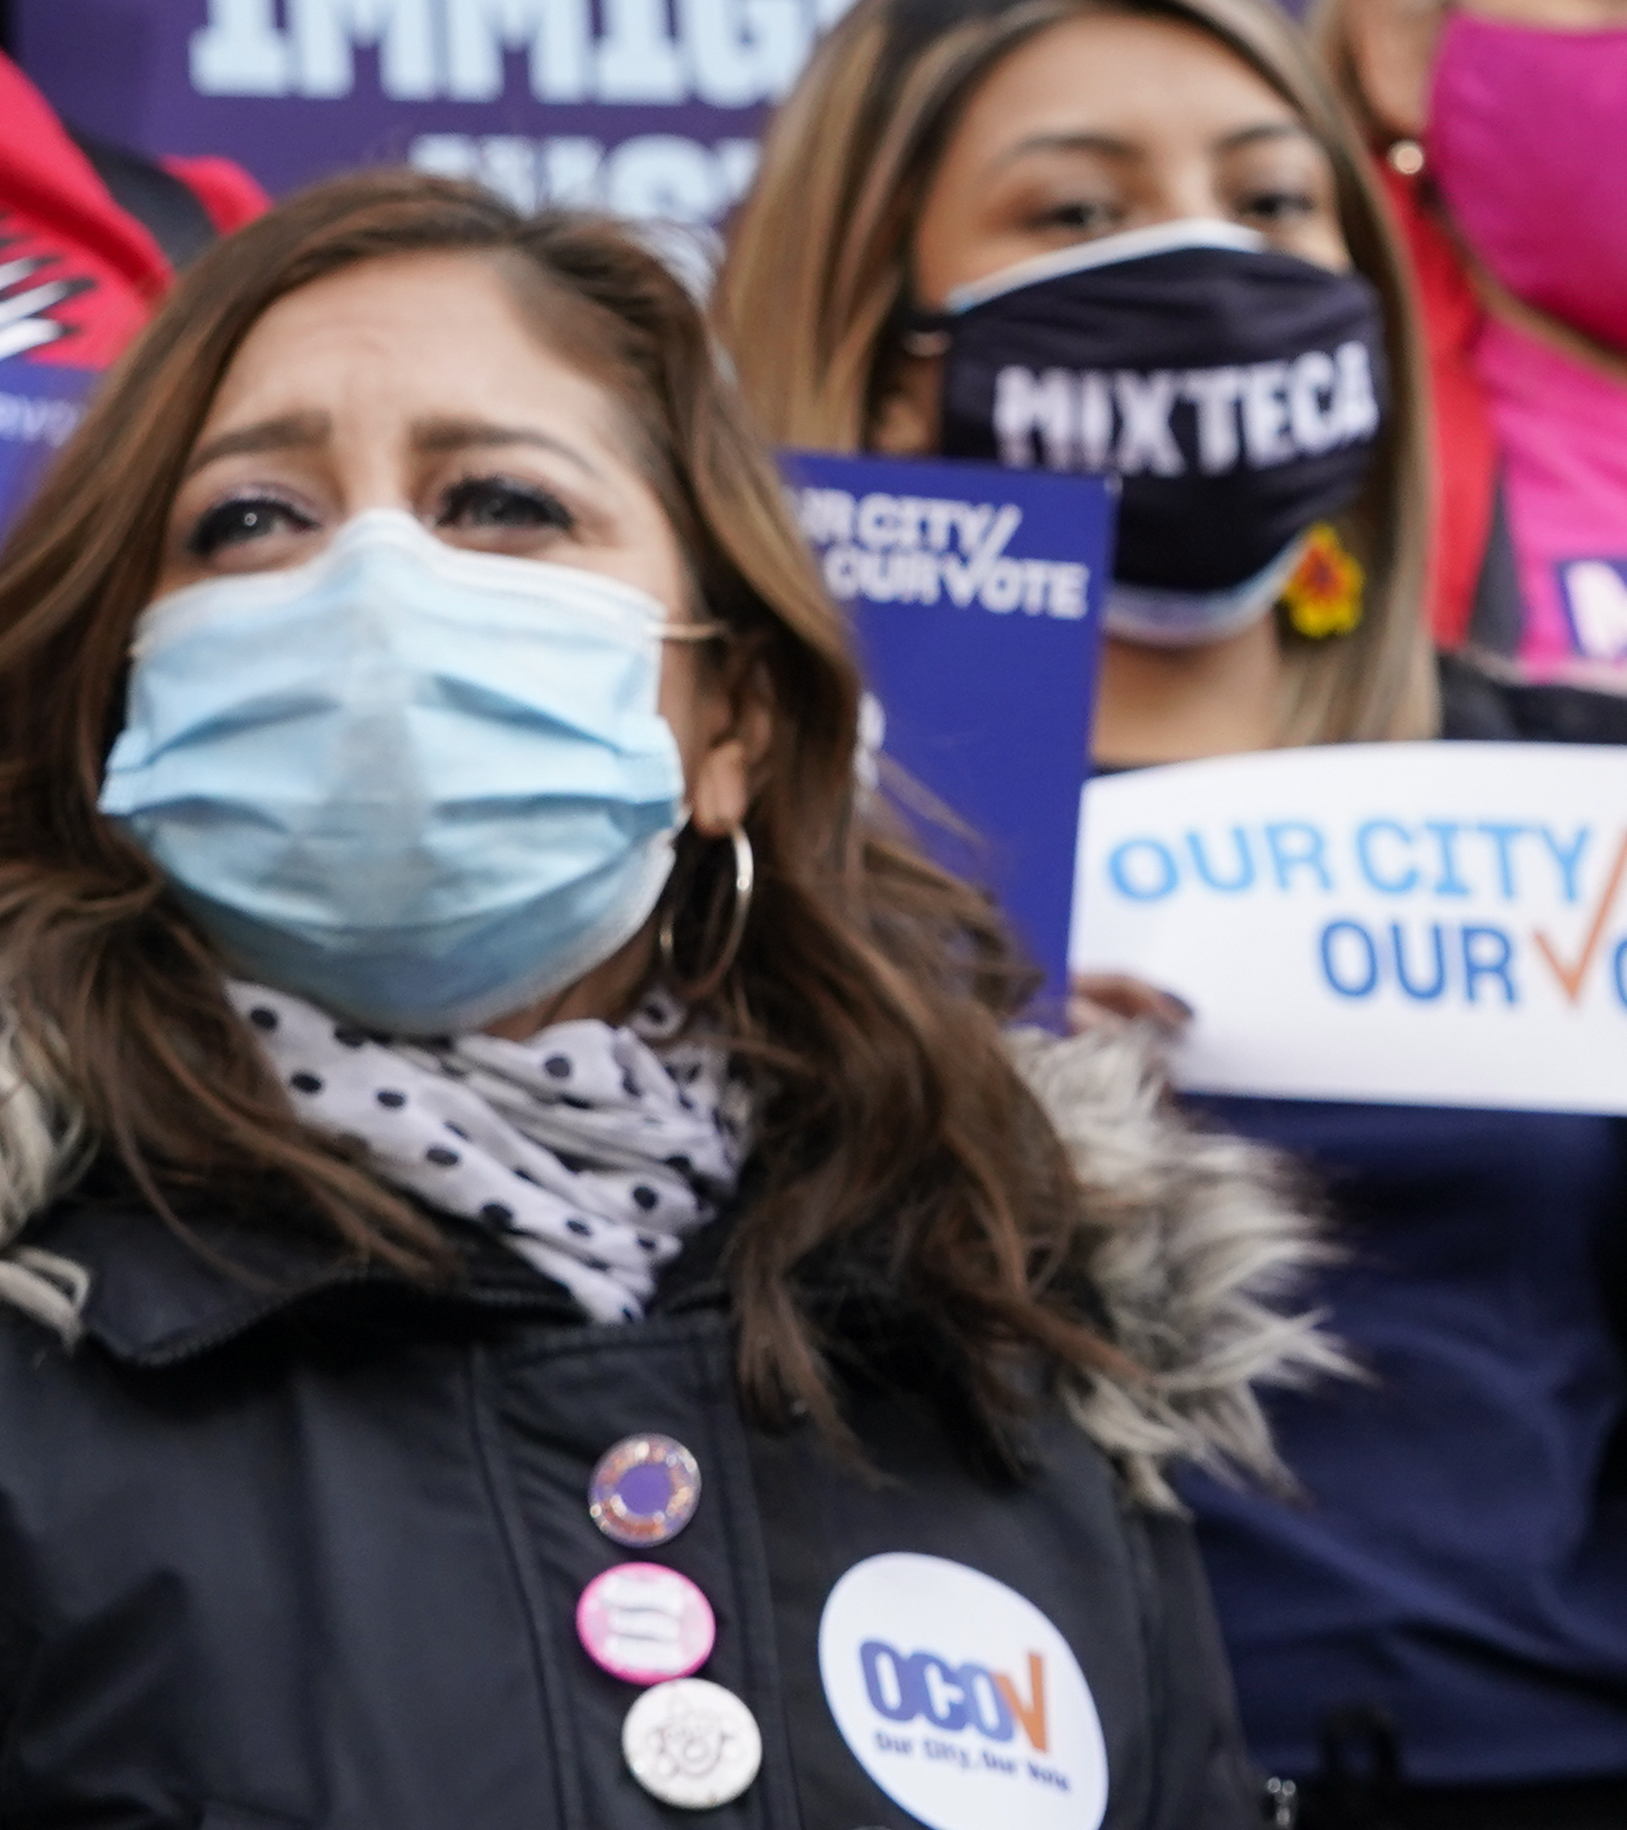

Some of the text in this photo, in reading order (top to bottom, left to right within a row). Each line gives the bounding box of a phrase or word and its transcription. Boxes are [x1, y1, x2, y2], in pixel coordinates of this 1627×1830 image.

[994, 342, 1379, 476] MIXTECA
[858, 492, 996, 556] CITY
[824, 546, 941, 606] OUR
[1106, 816, 1591, 905] OUR CITY
[1317, 918, 1518, 1008] OUR
[859, 1639, 1048, 1754] OCOV
